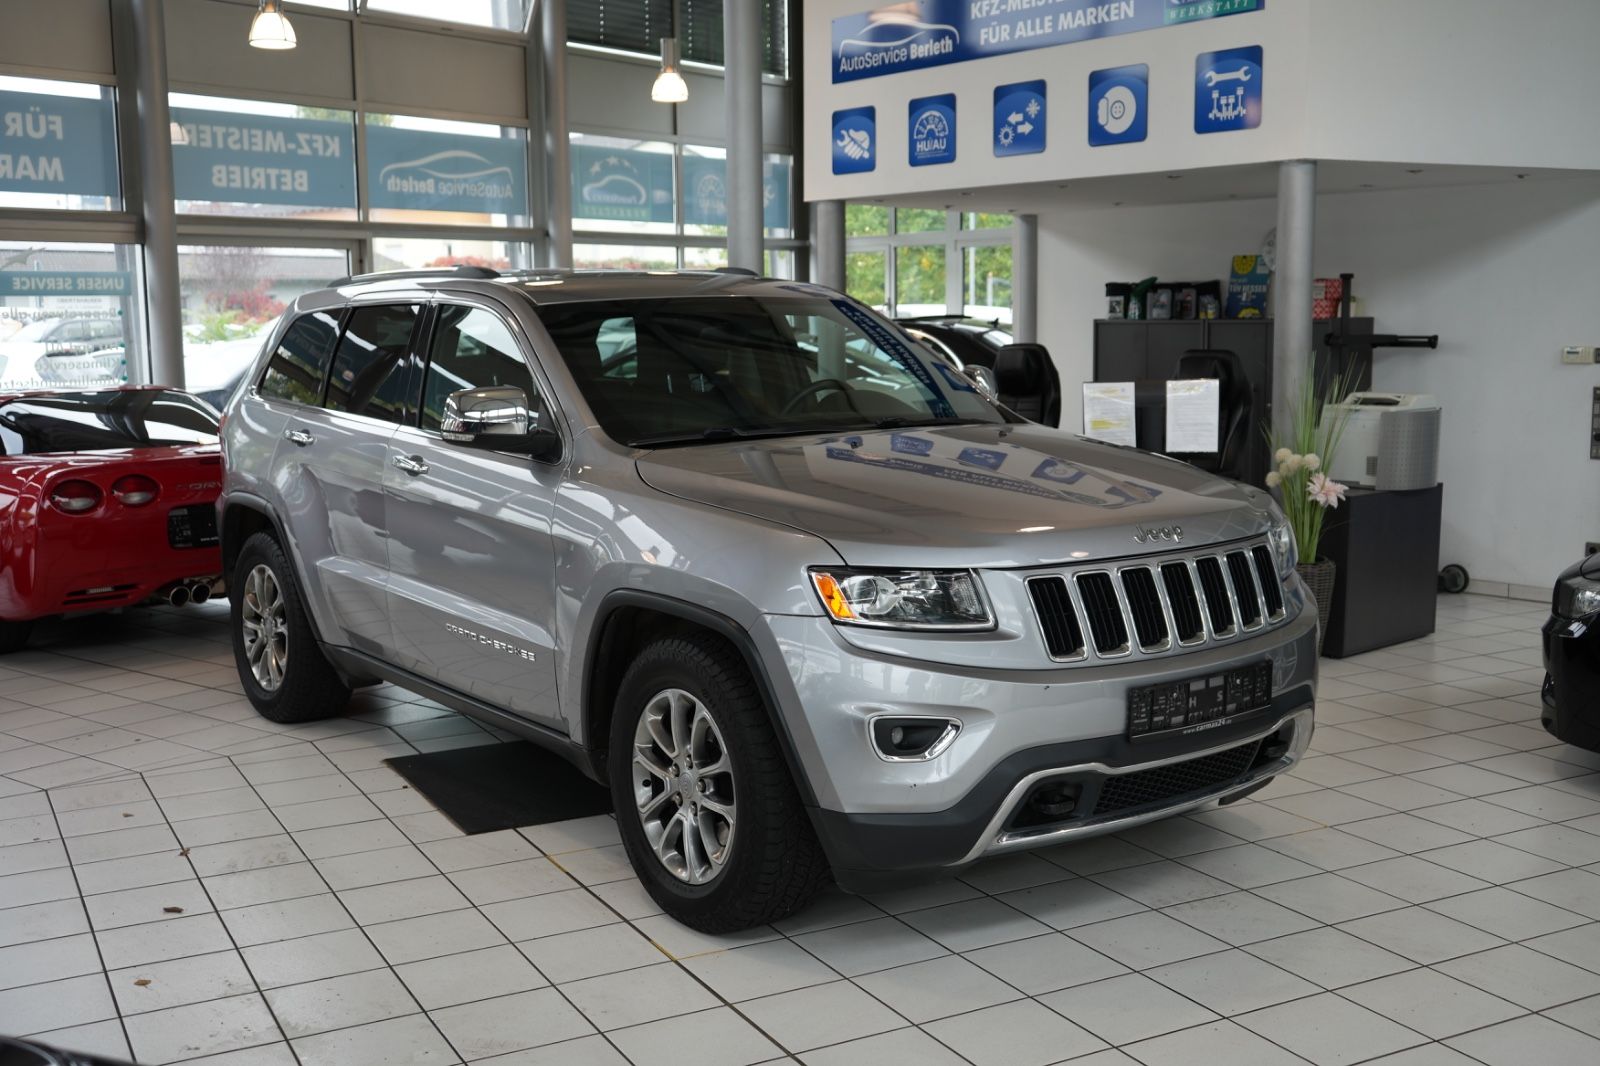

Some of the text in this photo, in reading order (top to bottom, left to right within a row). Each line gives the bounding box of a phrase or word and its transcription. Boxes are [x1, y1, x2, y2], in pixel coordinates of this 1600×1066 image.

[970, 0, 1064, 20] KFZ-MEI
[979, 1, 1135, 46] FÜR ALLE MARKEN
[839, 35, 953, 72] AutoService Berleth
[916, 138, 947, 153] HU/AU
[1132, 523, 1182, 542] Jeep
